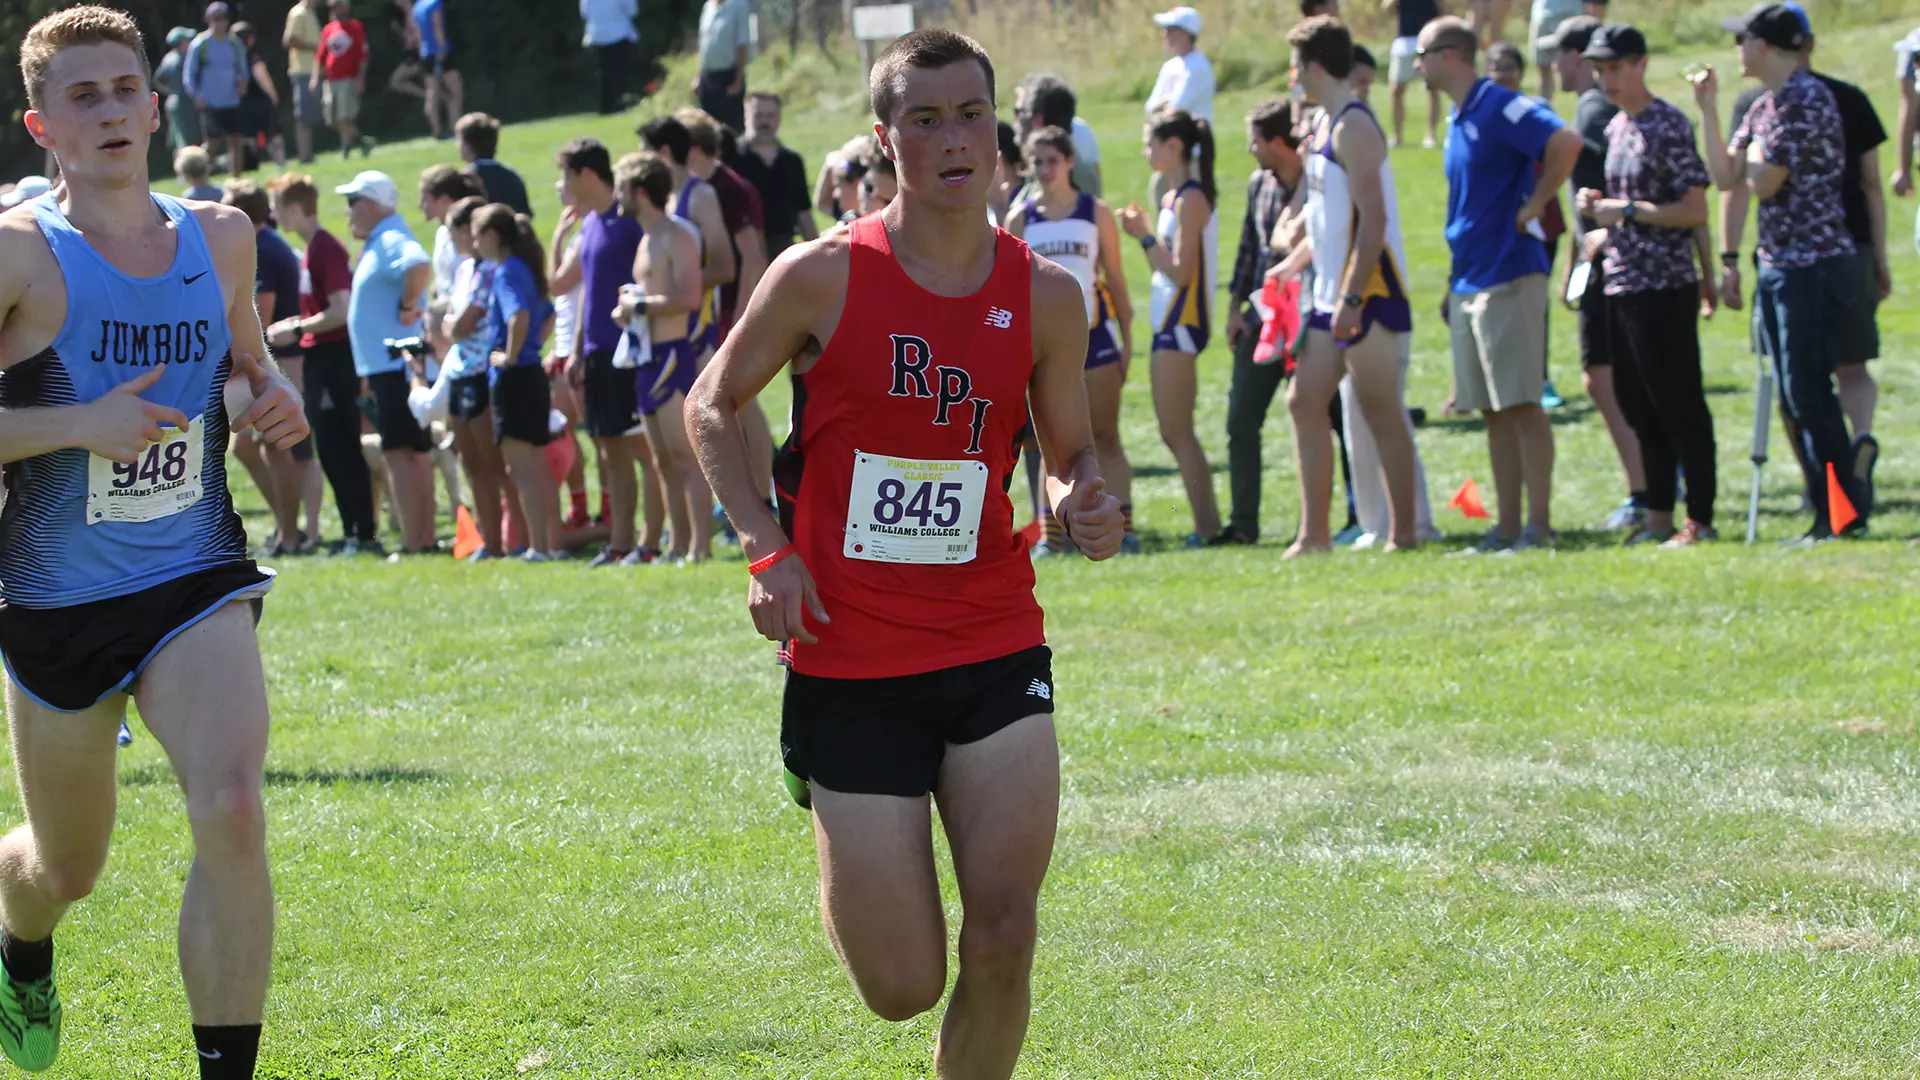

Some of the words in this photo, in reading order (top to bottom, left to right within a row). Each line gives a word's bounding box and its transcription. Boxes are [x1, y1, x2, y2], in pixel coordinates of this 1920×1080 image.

[90, 319, 209, 367] JUMBOS
[888, 333, 993, 454] RPI
[112, 441, 188, 489] 948
[887, 459, 925, 471] PURPLE
[928, 462, 962, 472] VALLEY
[904, 472, 944, 481] CLASSIC
[108, 487, 152, 498] WILLIAMS
[153, 478, 186, 494] COLLEGE
[873, 478, 963, 528] 845
[869, 523, 918, 537] WILLIAMS
[920, 528, 961, 537] COLLEGE
